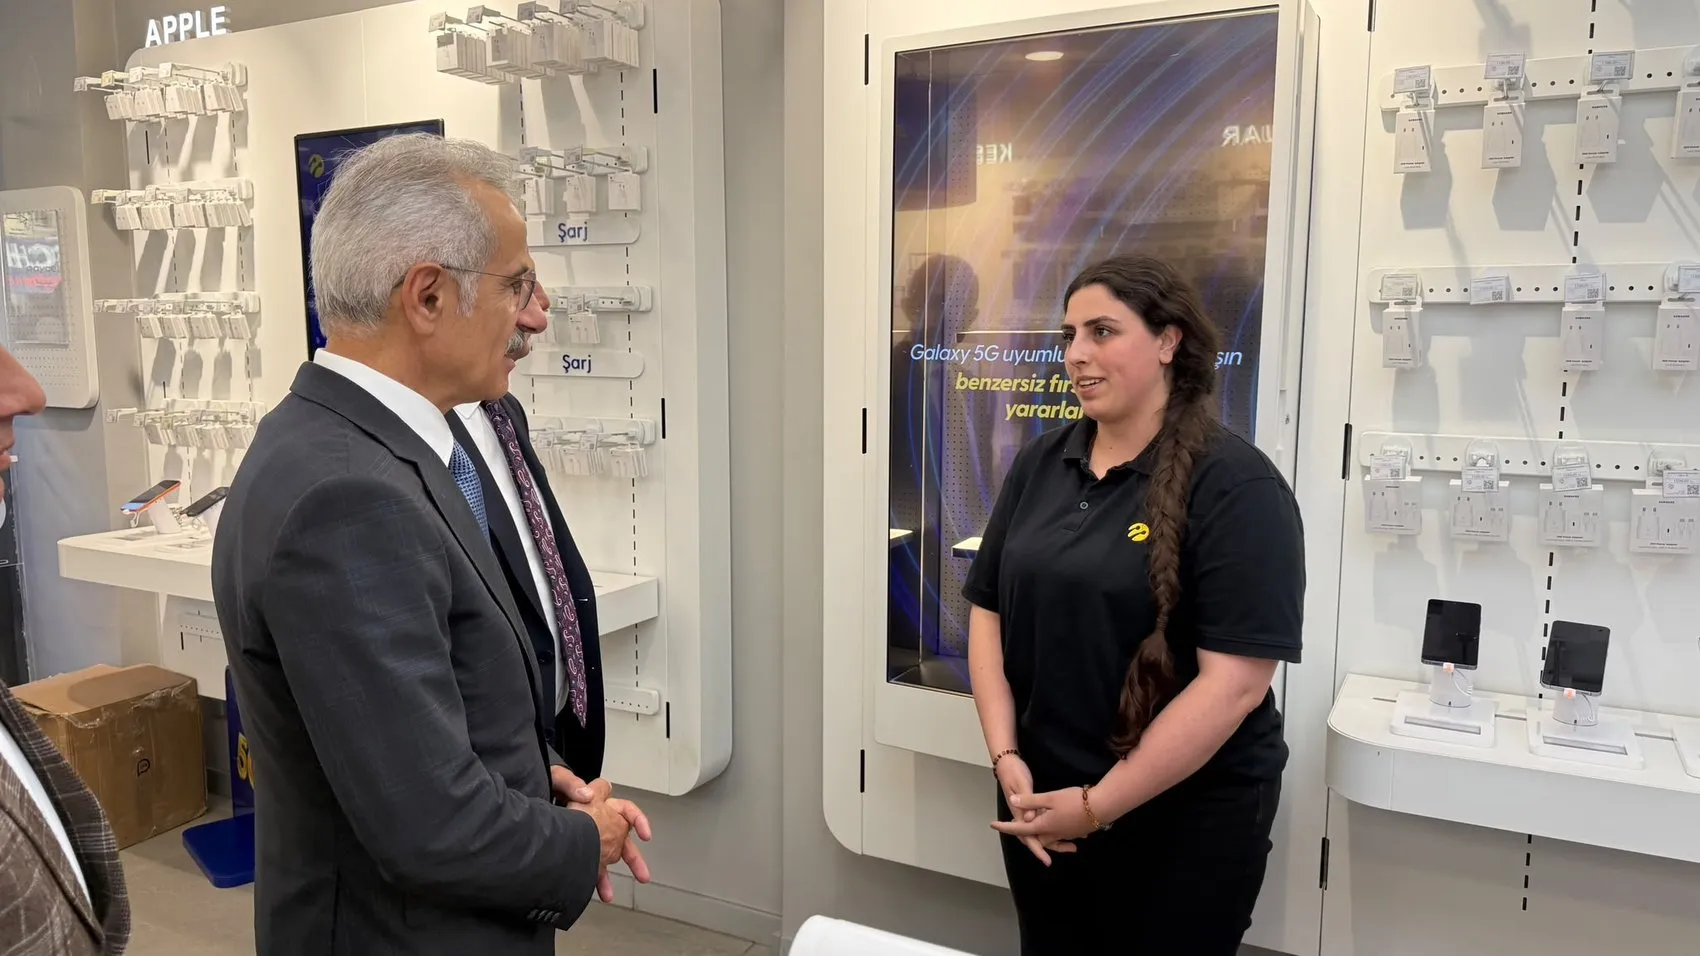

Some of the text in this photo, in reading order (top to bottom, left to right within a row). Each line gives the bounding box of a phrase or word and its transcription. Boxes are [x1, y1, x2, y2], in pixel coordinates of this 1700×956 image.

[145, 6, 227, 48] APPLE
[558, 221, 588, 243] Şarj
[562, 354, 591, 373] Şarj
[910, 343, 969, 365] Galaxy
[973, 345, 1000, 361] 5G
[955, 372, 1045, 393] benzersiz
[237, 732, 255, 789] 5
